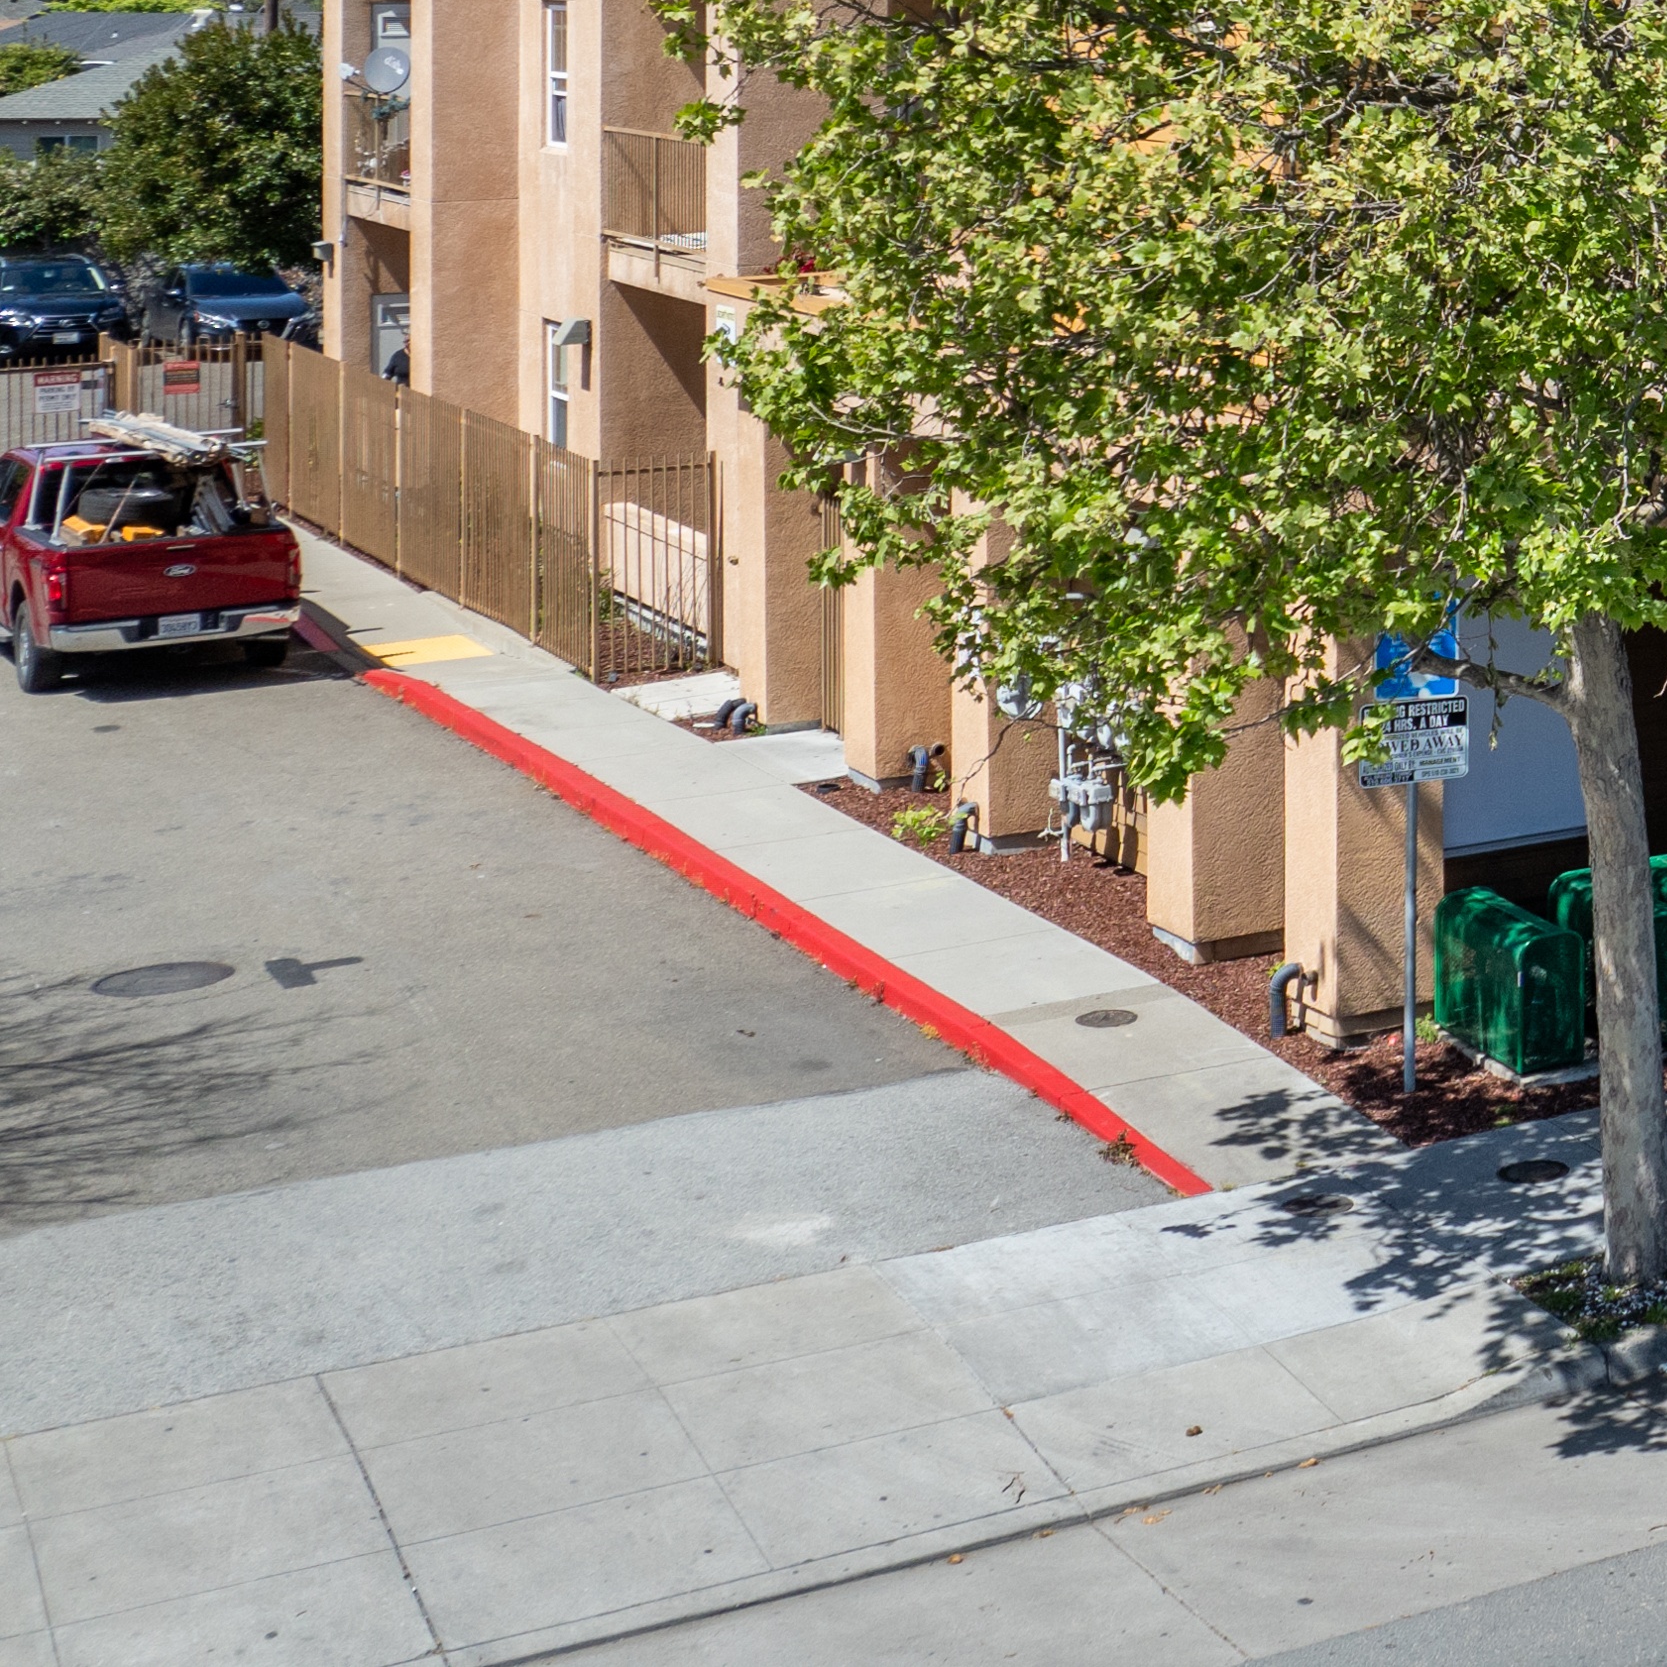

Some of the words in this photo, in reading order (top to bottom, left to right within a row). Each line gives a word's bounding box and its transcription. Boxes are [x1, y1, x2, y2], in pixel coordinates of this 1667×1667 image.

[1408, 699, 1465, 718] RESTRICTED
[1394, 717, 1417, 732] HRS.
[1420, 716, 1427, 729] A
[1429, 714, 1449, 727] DAY
[1423, 734, 1464, 750] AWAY
